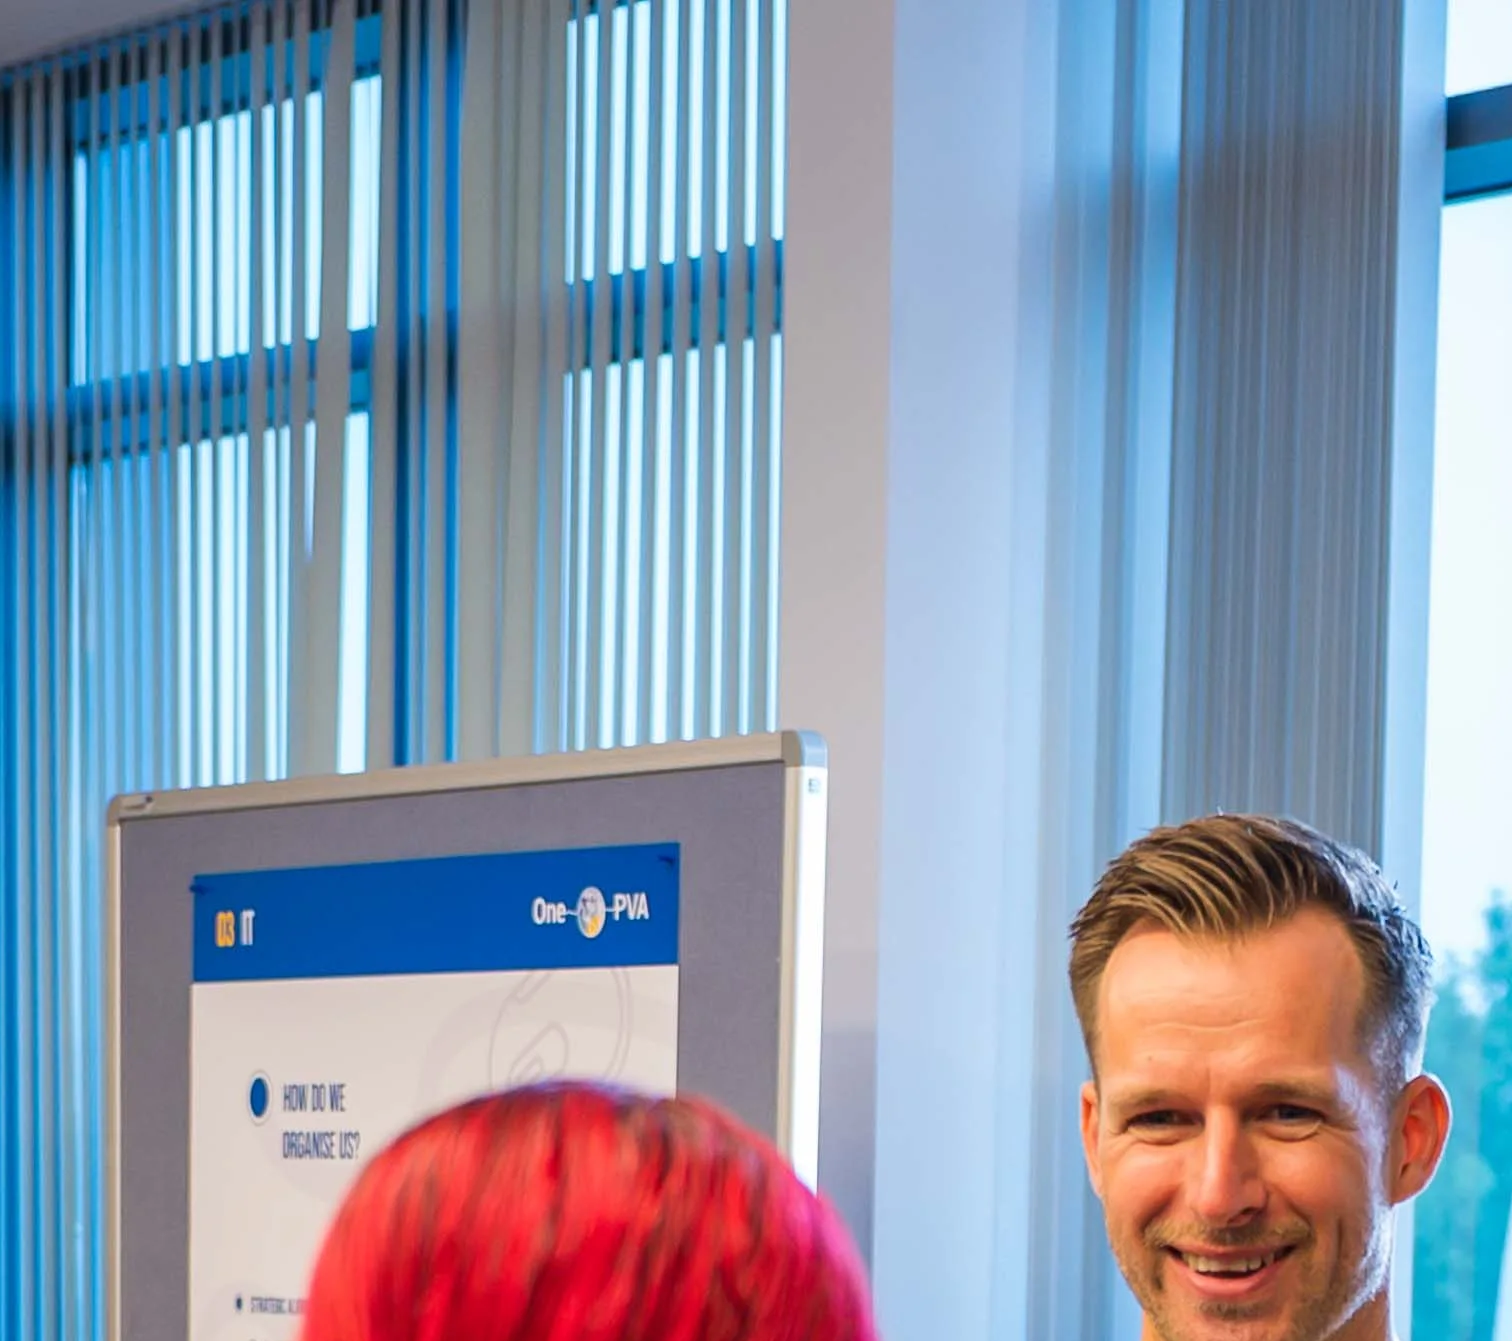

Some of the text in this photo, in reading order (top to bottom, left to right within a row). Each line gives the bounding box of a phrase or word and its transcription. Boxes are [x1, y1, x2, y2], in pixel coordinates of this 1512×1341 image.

[531, 891, 650, 926] One PVA
[240, 908, 256, 946] IT
[283, 1083, 346, 1112] HOW DO WE
[282, 1131, 361, 1159] ORGANISE US?
